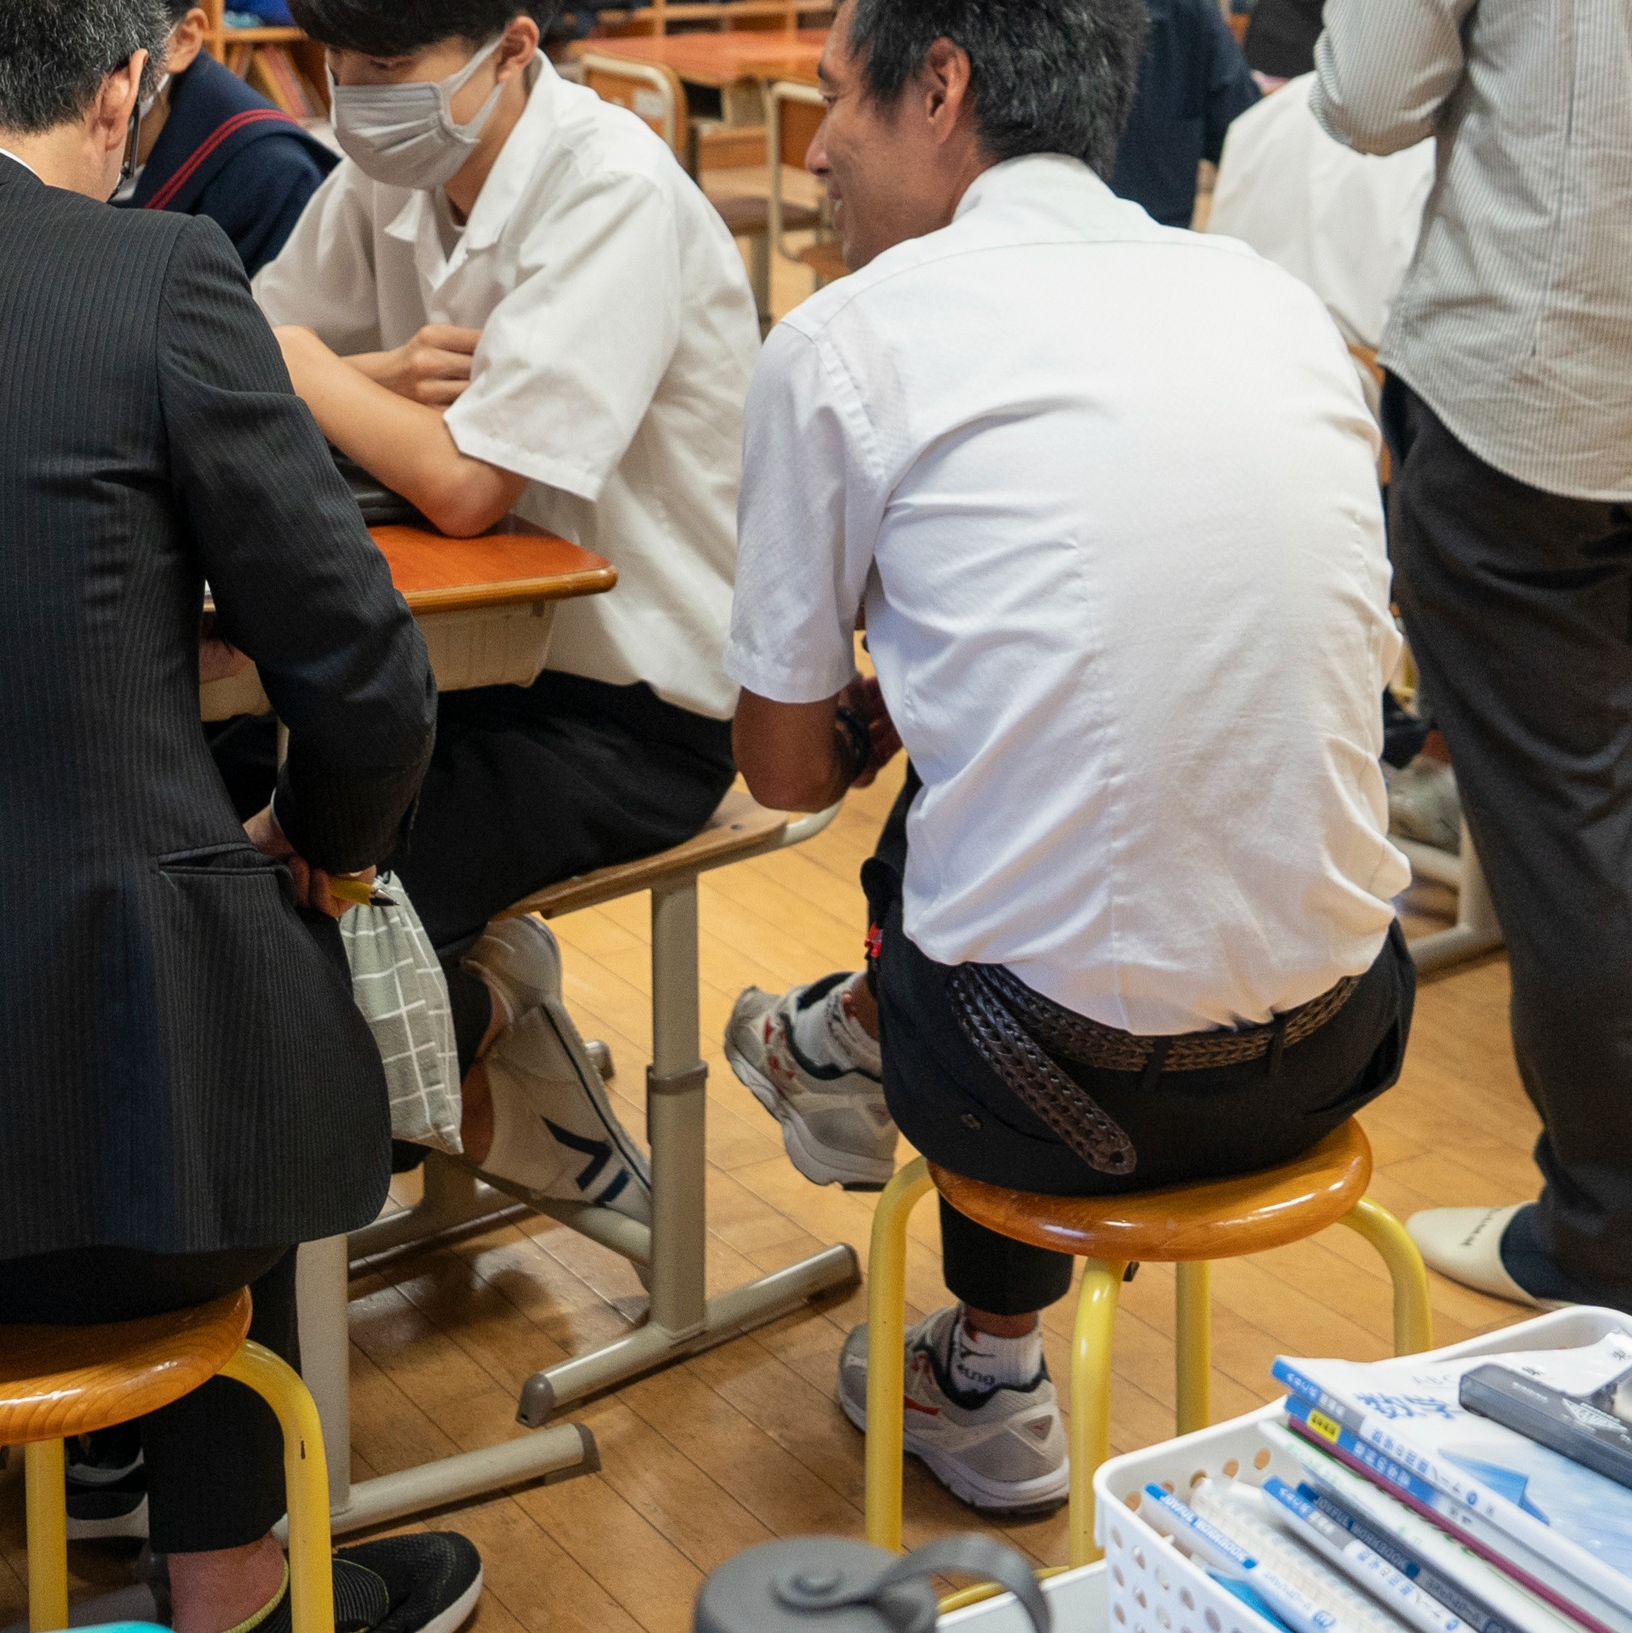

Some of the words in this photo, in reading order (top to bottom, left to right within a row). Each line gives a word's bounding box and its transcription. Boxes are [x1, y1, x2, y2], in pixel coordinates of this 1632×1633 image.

[1354, 1391, 1458, 1420] 数学
[1160, 1493, 1197, 1528] JOYFUL
[1193, 1515, 1247, 1565] WORKBOOK
[1315, 1494, 1352, 1529] JOYFUL
[1349, 1523, 1408, 1570] WORKBOOK
